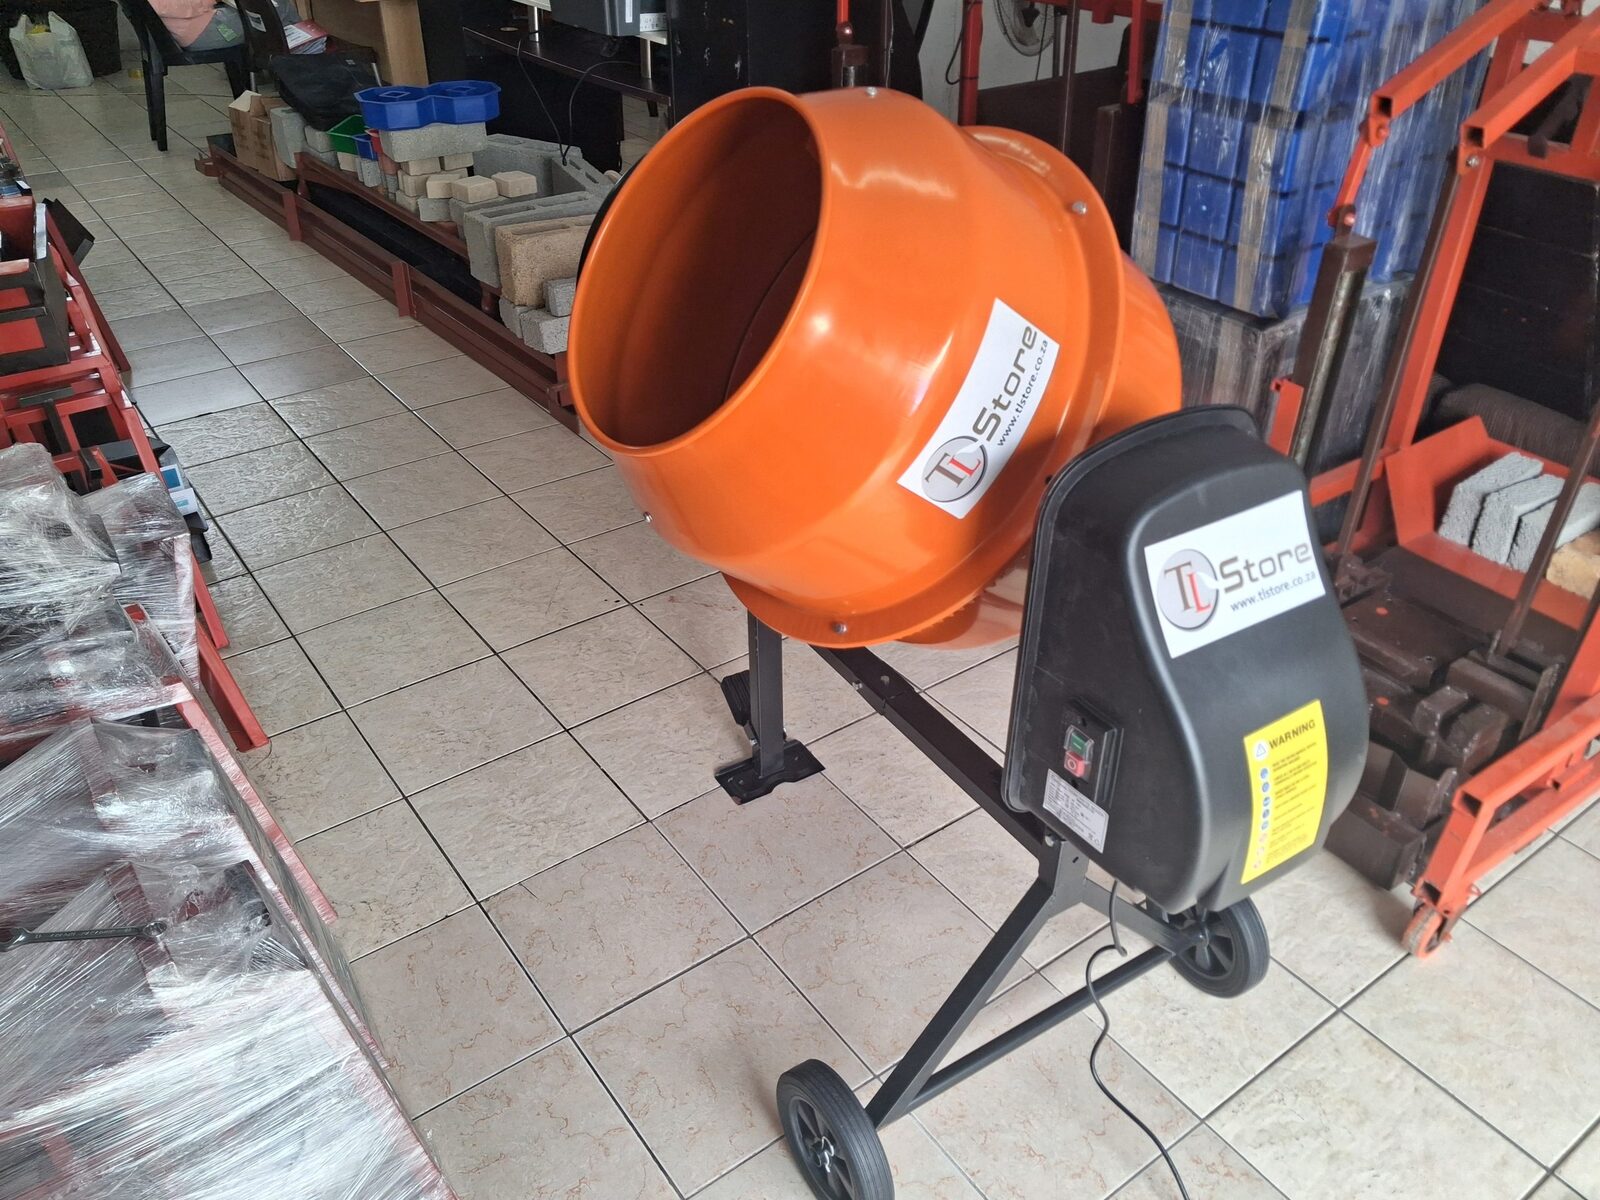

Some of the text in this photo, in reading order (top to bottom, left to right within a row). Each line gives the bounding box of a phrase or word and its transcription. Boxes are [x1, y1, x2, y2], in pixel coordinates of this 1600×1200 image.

[973, 325, 1038, 442] Store
[997, 340, 1048, 447] www.tlstore.co.za
[1219, 542, 1313, 594] Store
[1230, 571, 1316, 612] www.tlstore.co.za
[1268, 719, 1316, 750] WARNING
